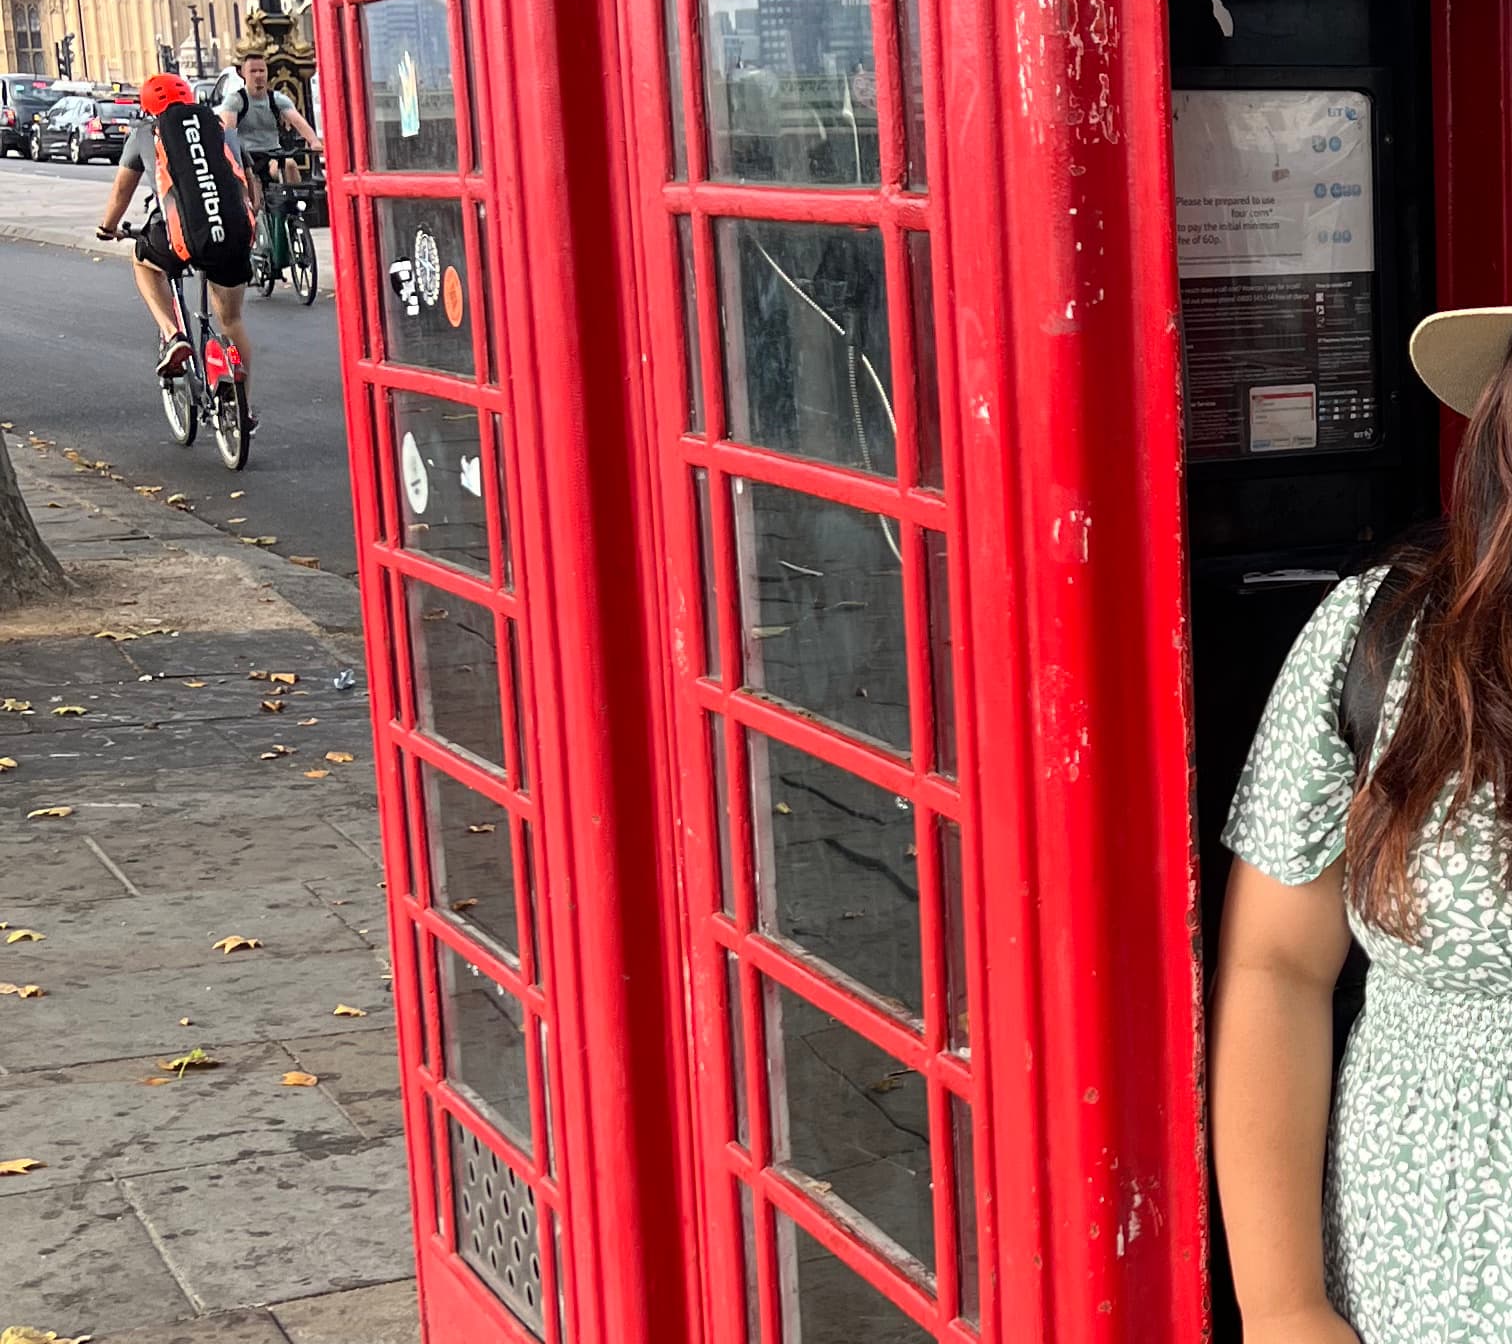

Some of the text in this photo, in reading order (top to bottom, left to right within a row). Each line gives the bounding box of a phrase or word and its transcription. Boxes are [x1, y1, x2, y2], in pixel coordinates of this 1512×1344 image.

[182, 114, 225, 242] Tecnifibre
[1176, 196, 1201, 206] Please
[1203, 197, 1212, 205] be
[1214, 195, 1250, 207] prepared
[1252, 196, 1260, 204] to
[1187, 224, 1202, 233] pay
[1203, 222, 1217, 231] the
[1191, 235, 1201, 244] of
